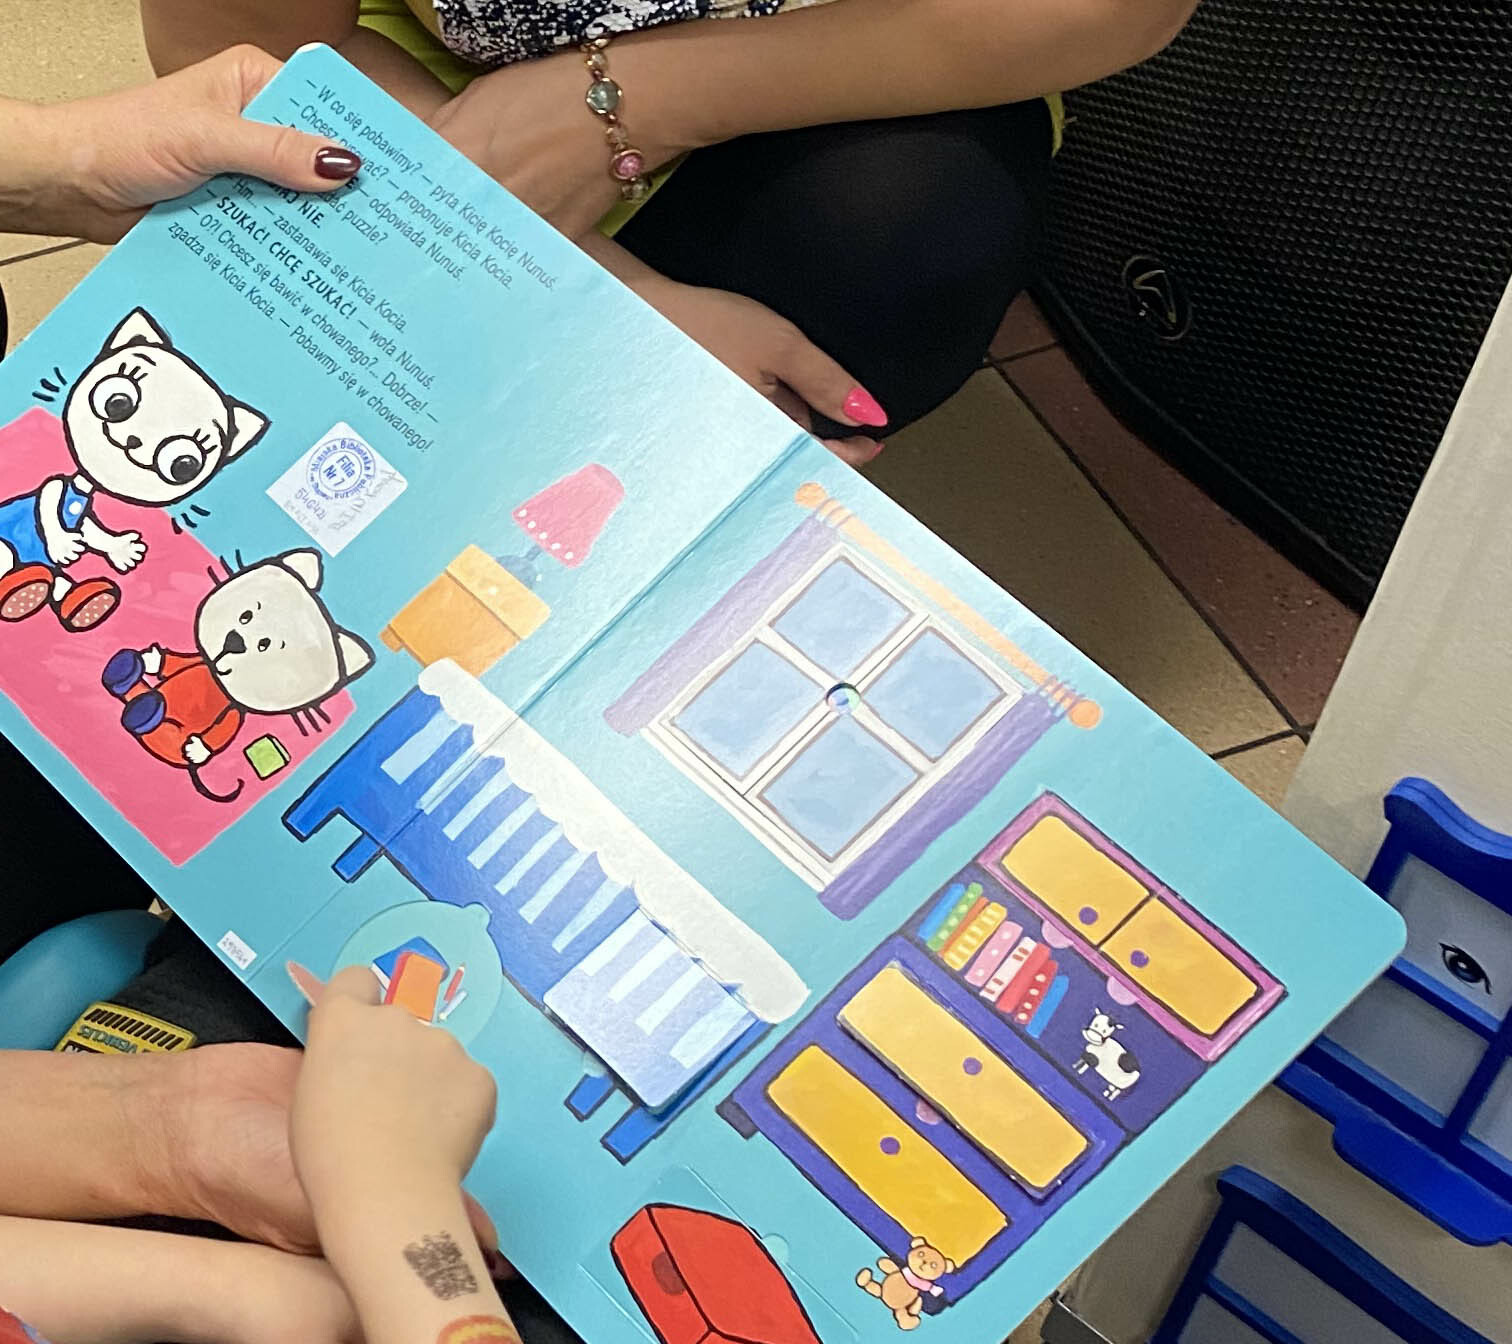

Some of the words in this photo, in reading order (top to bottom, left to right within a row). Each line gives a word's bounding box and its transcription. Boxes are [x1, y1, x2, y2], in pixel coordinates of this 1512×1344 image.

[299, 104, 340, 142] Chcesz
[394, 188, 454, 238] proponuje
[450, 229, 482, 261] Kicia
[479, 253, 514, 290] Kocia.
[316, 84, 336, 104] W
[329, 99, 346, 115] co
[342, 109, 364, 132] się
[356, 123, 423, 177] pobawimy?
[428, 183, 460, 211] pyta
[456, 201, 488, 235] Kicię
[483, 225, 519, 260] Kocię
[340, 208, 388, 247] puzzle?
[367, 196, 427, 249] odpowiada
[424, 241, 467, 281] Nunuś.
[166, 220, 206, 257] zgadza
[202, 251, 222, 272] się
[218, 262, 248, 293] Kicia
[243, 285, 277, 320] Kocia.
[288, 324, 343, 376] Pobawmy
[336, 366, 360, 391] się
[354, 384, 370, 399] w
[365, 393, 434, 454] chowanego!
[215, 195, 270, 245] SZUKAĆ!
[267, 240, 304, 276] CHCĘ
[300, 268, 357, 320] SZUKAĆ!
[368, 328, 398, 357] woła
[394, 349, 436, 390] Nunuś.
[217, 228, 257, 267] Chcesz
[251, 261, 272, 283] się
[268, 272, 304, 307] bawić
[299, 302, 314, 317] w
[380, 370, 428, 414] Dobrze!
[272, 214, 333, 268] zastanawia
[327, 262, 350, 285] się
[346, 275, 377, 306] Kicia
[373, 298, 408, 334] Kocia.
[324, 464, 337, 481] Nr
[333, 477, 345, 487] 7
[335, 454, 356, 478] Filia
